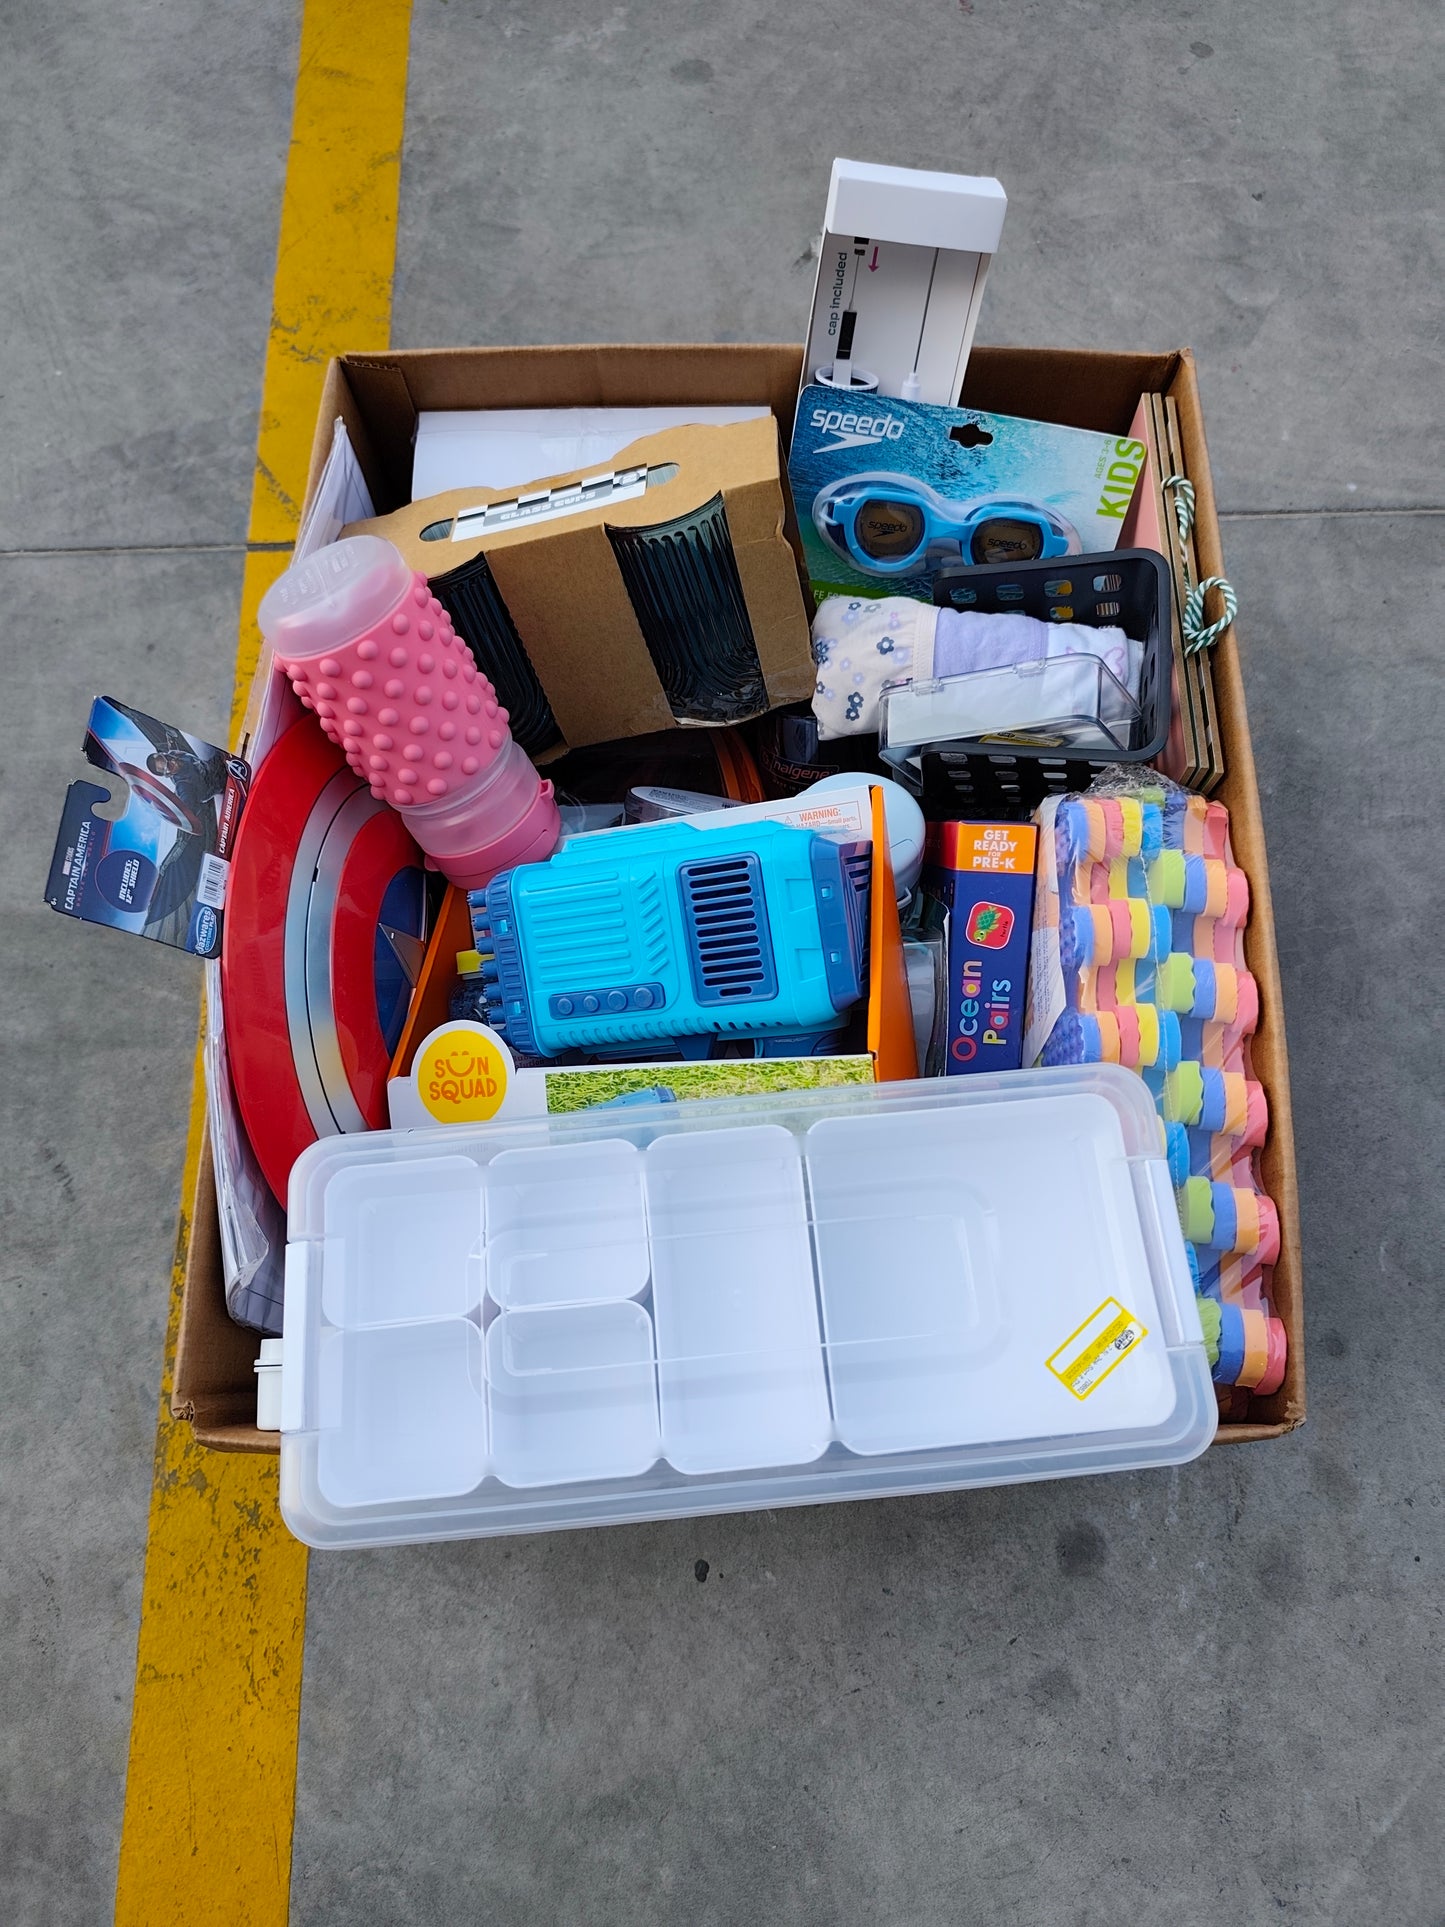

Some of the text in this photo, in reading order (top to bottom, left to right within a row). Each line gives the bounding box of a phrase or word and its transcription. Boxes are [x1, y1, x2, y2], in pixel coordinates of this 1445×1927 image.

[828, 252, 848, 336] cap included
[810, 408, 905, 442] speedo
[1094, 452, 1107, 480] AGES
[1095, 438, 1146, 520] KIDS
[500, 503, 552, 520] GLASS
[867, 519, 908, 534] speedo
[986, 537, 1028, 551] speedo
[773, 760, 830, 780] nalgene
[219, 824, 231, 854] CAPTAIN
[225, 788, 236, 823] AMERICA
[799, 807, 842, 822] WARNING:
[973, 839, 1018, 852] READY
[983, 829, 1010, 841] GET
[64, 820, 92, 911] CAPTAIN AMERICA
[128, 859, 140, 889] SHIELD
[972, 856, 1017, 870] PRE-K
[118, 859, 133, 901] INCLUDES:
[50, 897, 57, 905] 6+
[195, 910, 212, 954] Jazwares
[951, 960, 983, 1062] Ocean
[982, 979, 1012, 1045] Pairs
[434, 1056, 490, 1079] SUN
[429, 1077, 498, 1104] SQUAD
